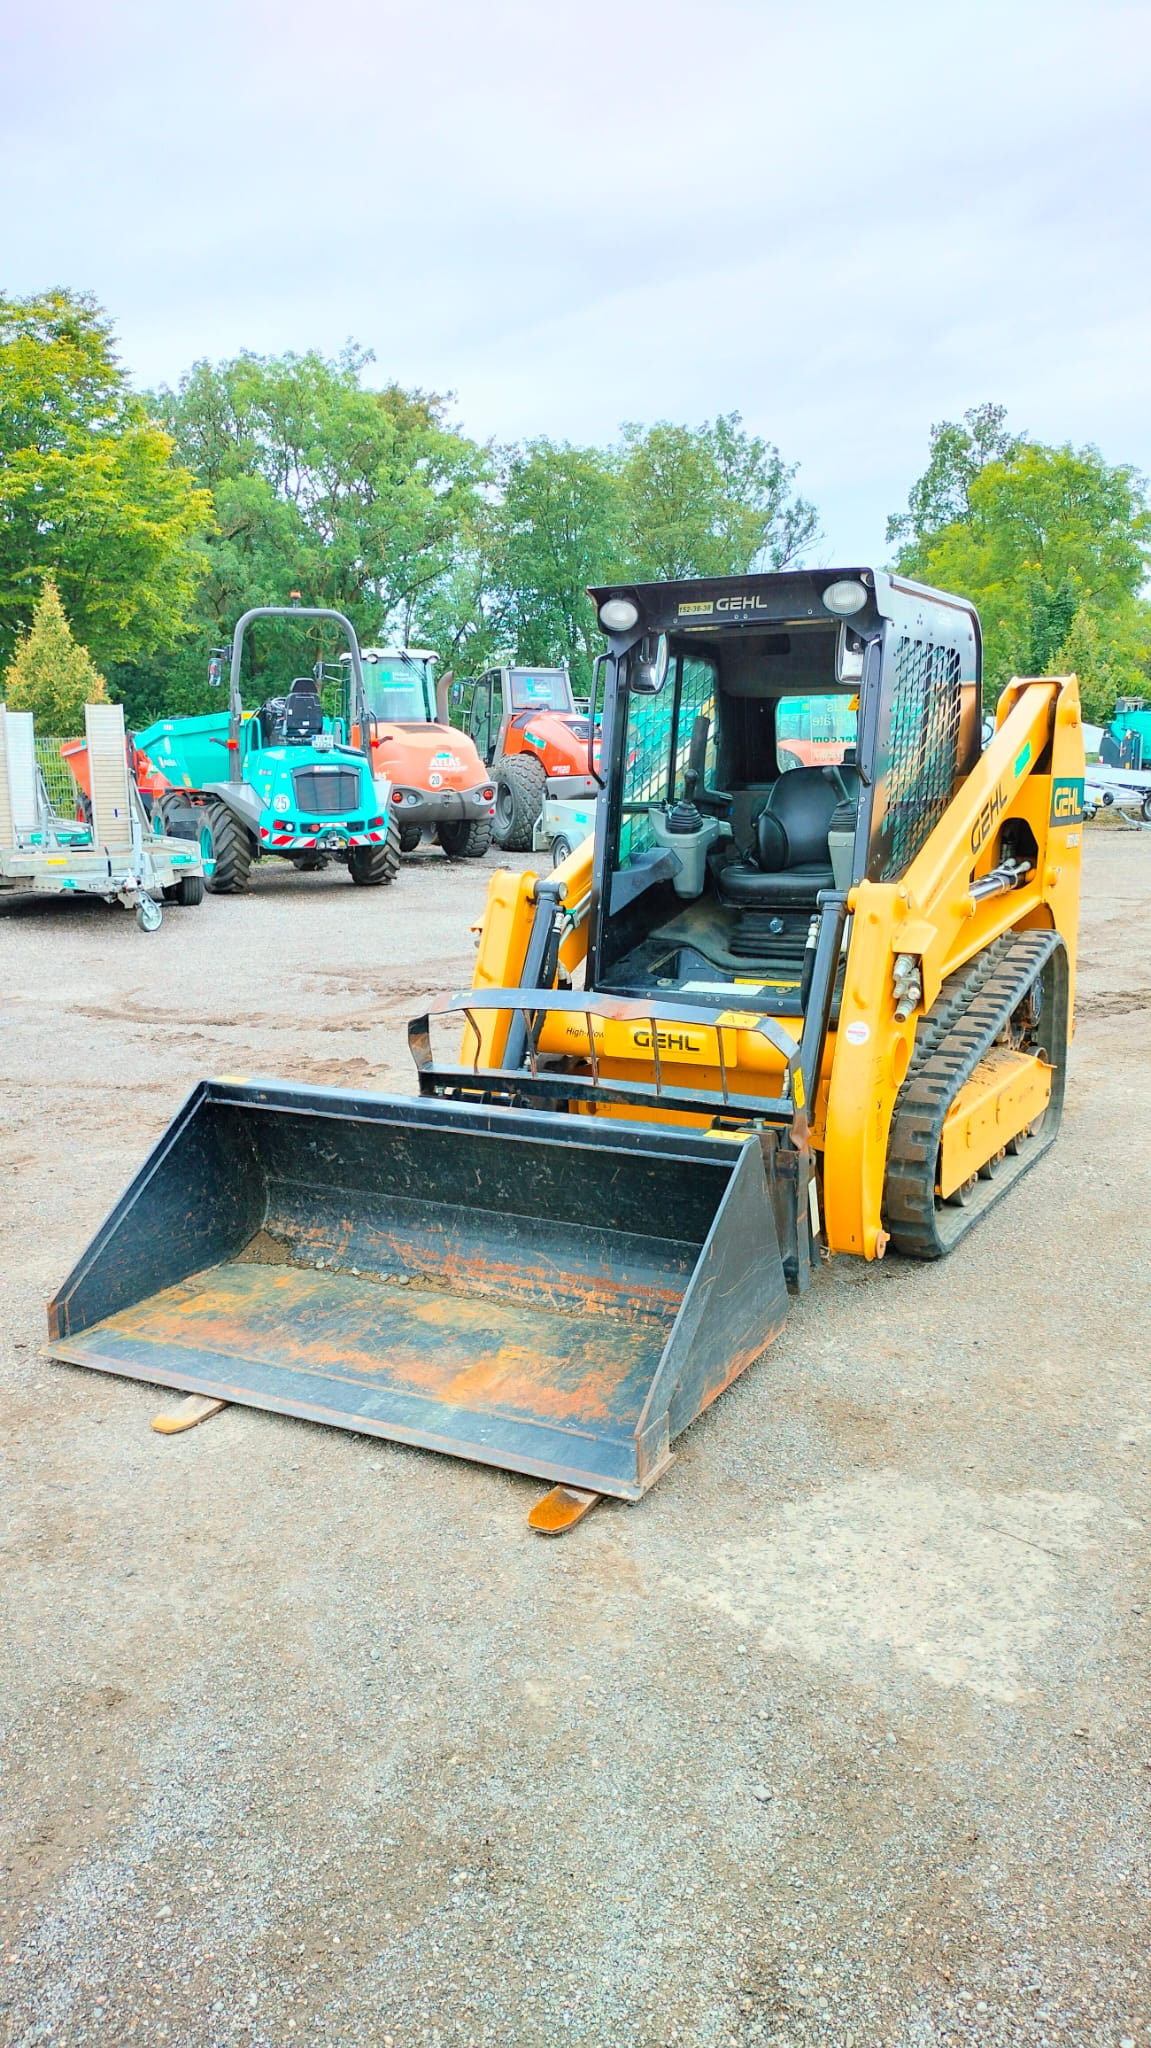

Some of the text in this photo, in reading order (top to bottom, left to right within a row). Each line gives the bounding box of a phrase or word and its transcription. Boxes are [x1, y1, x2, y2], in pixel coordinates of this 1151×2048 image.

[715, 595, 768, 611] GEHL
[431, 775, 440, 785] 20
[275, 796, 287, 810] 25
[1053, 787, 1082, 818] GEHL
[971, 783, 1008, 855] GEHL
[633, 1030, 700, 1052] GEHL
